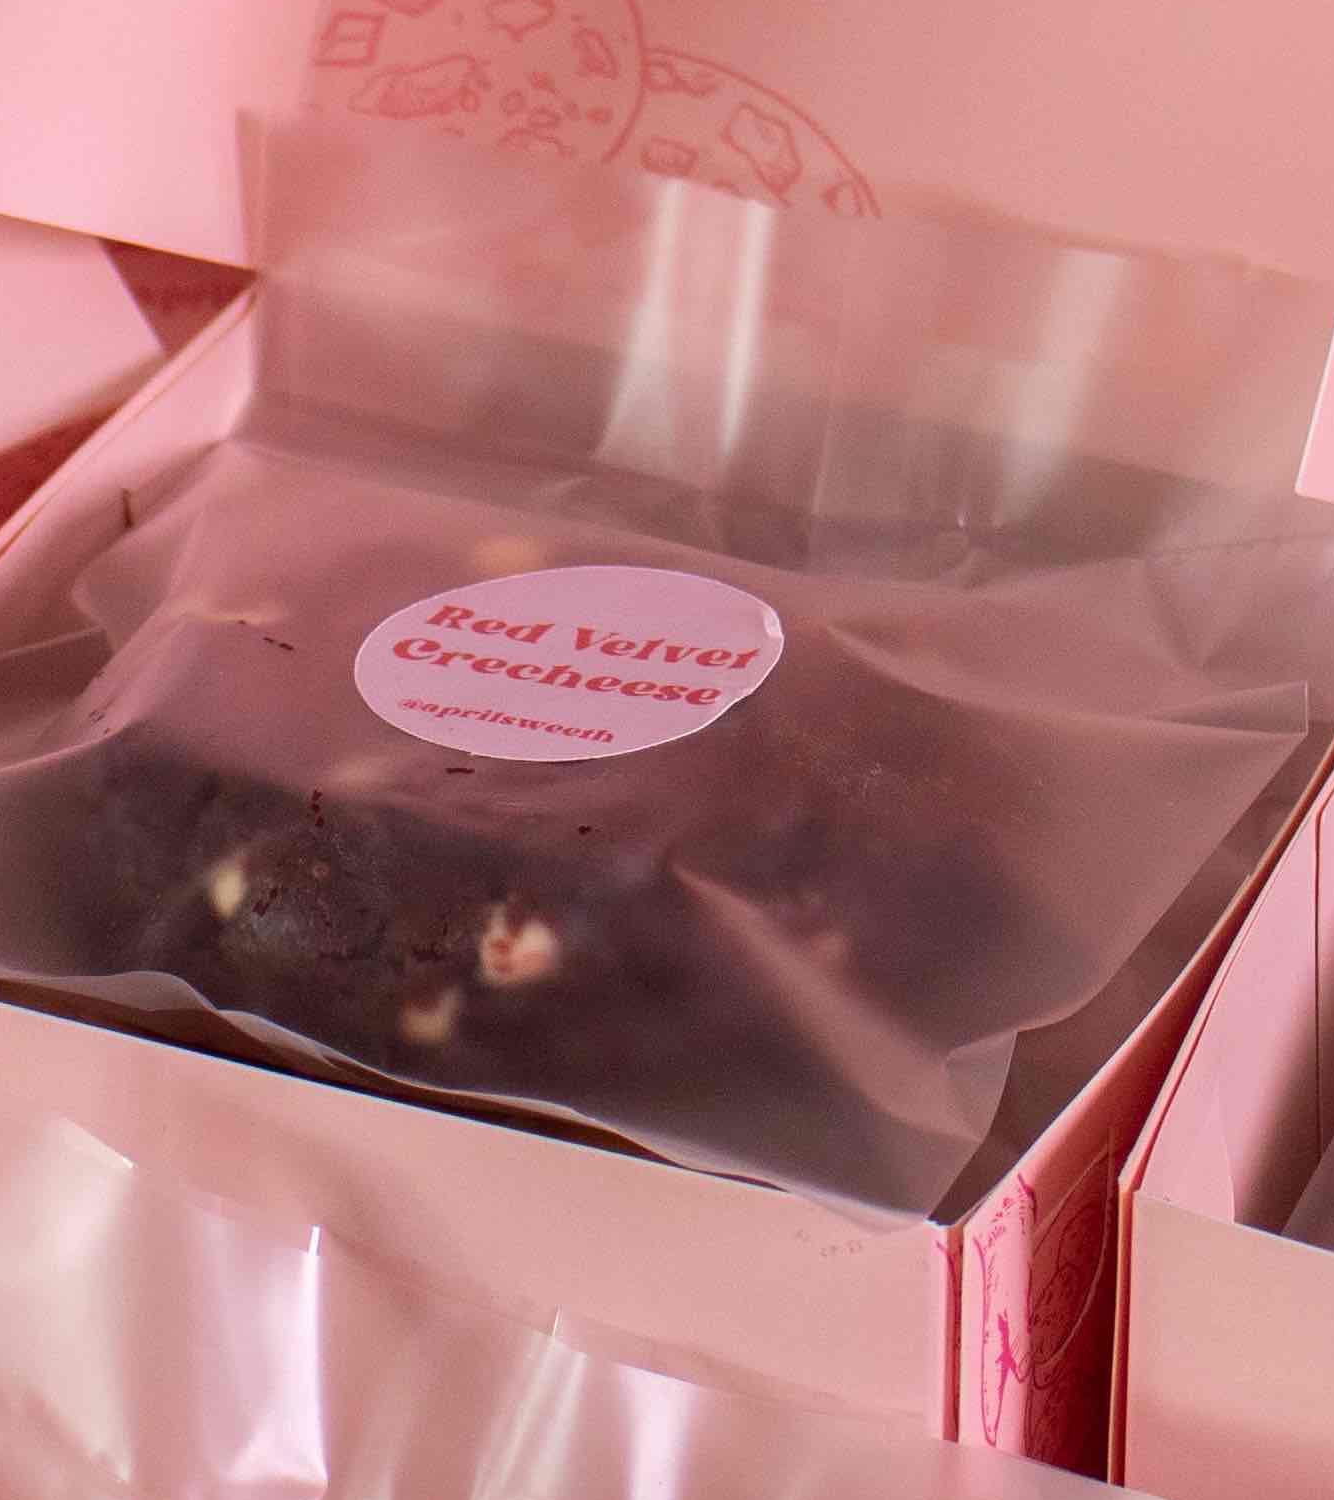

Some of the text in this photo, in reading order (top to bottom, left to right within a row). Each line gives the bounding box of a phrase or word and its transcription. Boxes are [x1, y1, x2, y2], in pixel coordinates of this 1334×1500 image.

[426, 603, 762, 670] Red Velvet
[392, 637, 723, 707] Crecheese
[401, 698, 616, 744] @aprilsweeth
